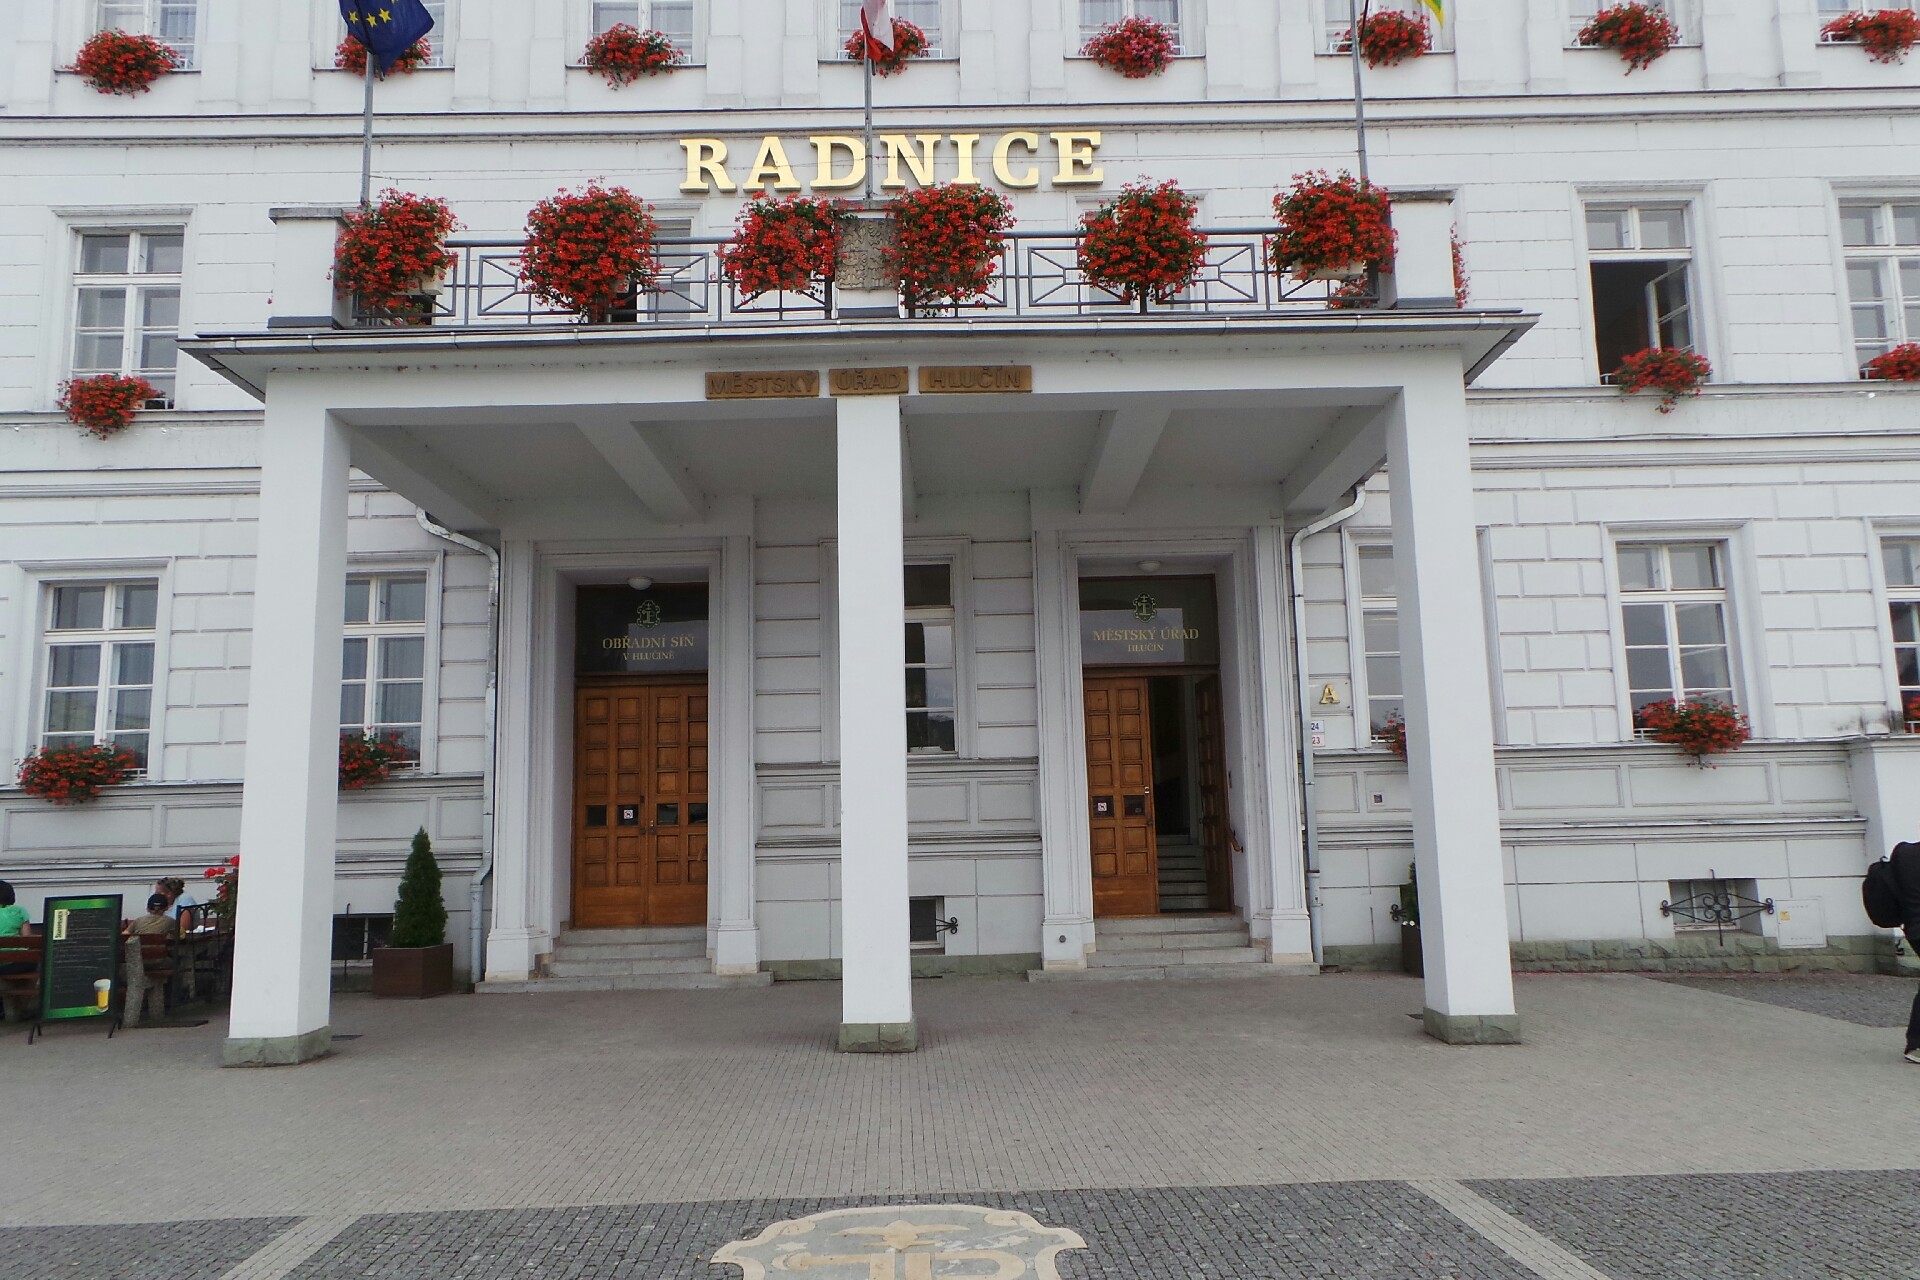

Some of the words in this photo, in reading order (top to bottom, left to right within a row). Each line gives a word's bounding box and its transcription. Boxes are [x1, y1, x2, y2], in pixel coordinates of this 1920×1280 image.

[679, 131, 1104, 194] RADNICE
[709, 371, 815, 395] MĚSTSKÝ
[836, 368, 900, 391] ÚŘAD
[928, 366, 1020, 389] HLUČÍN
[1093, 626, 1156, 641] MĚSTSKÝ
[1160, 626, 1199, 640] ÚŘAD
[602, 634, 666, 649] OBŘADNÍ
[1128, 642, 1164, 652] HLUČÍN
[623, 652, 630, 660] V
[1320, 683, 1341, 705] A
